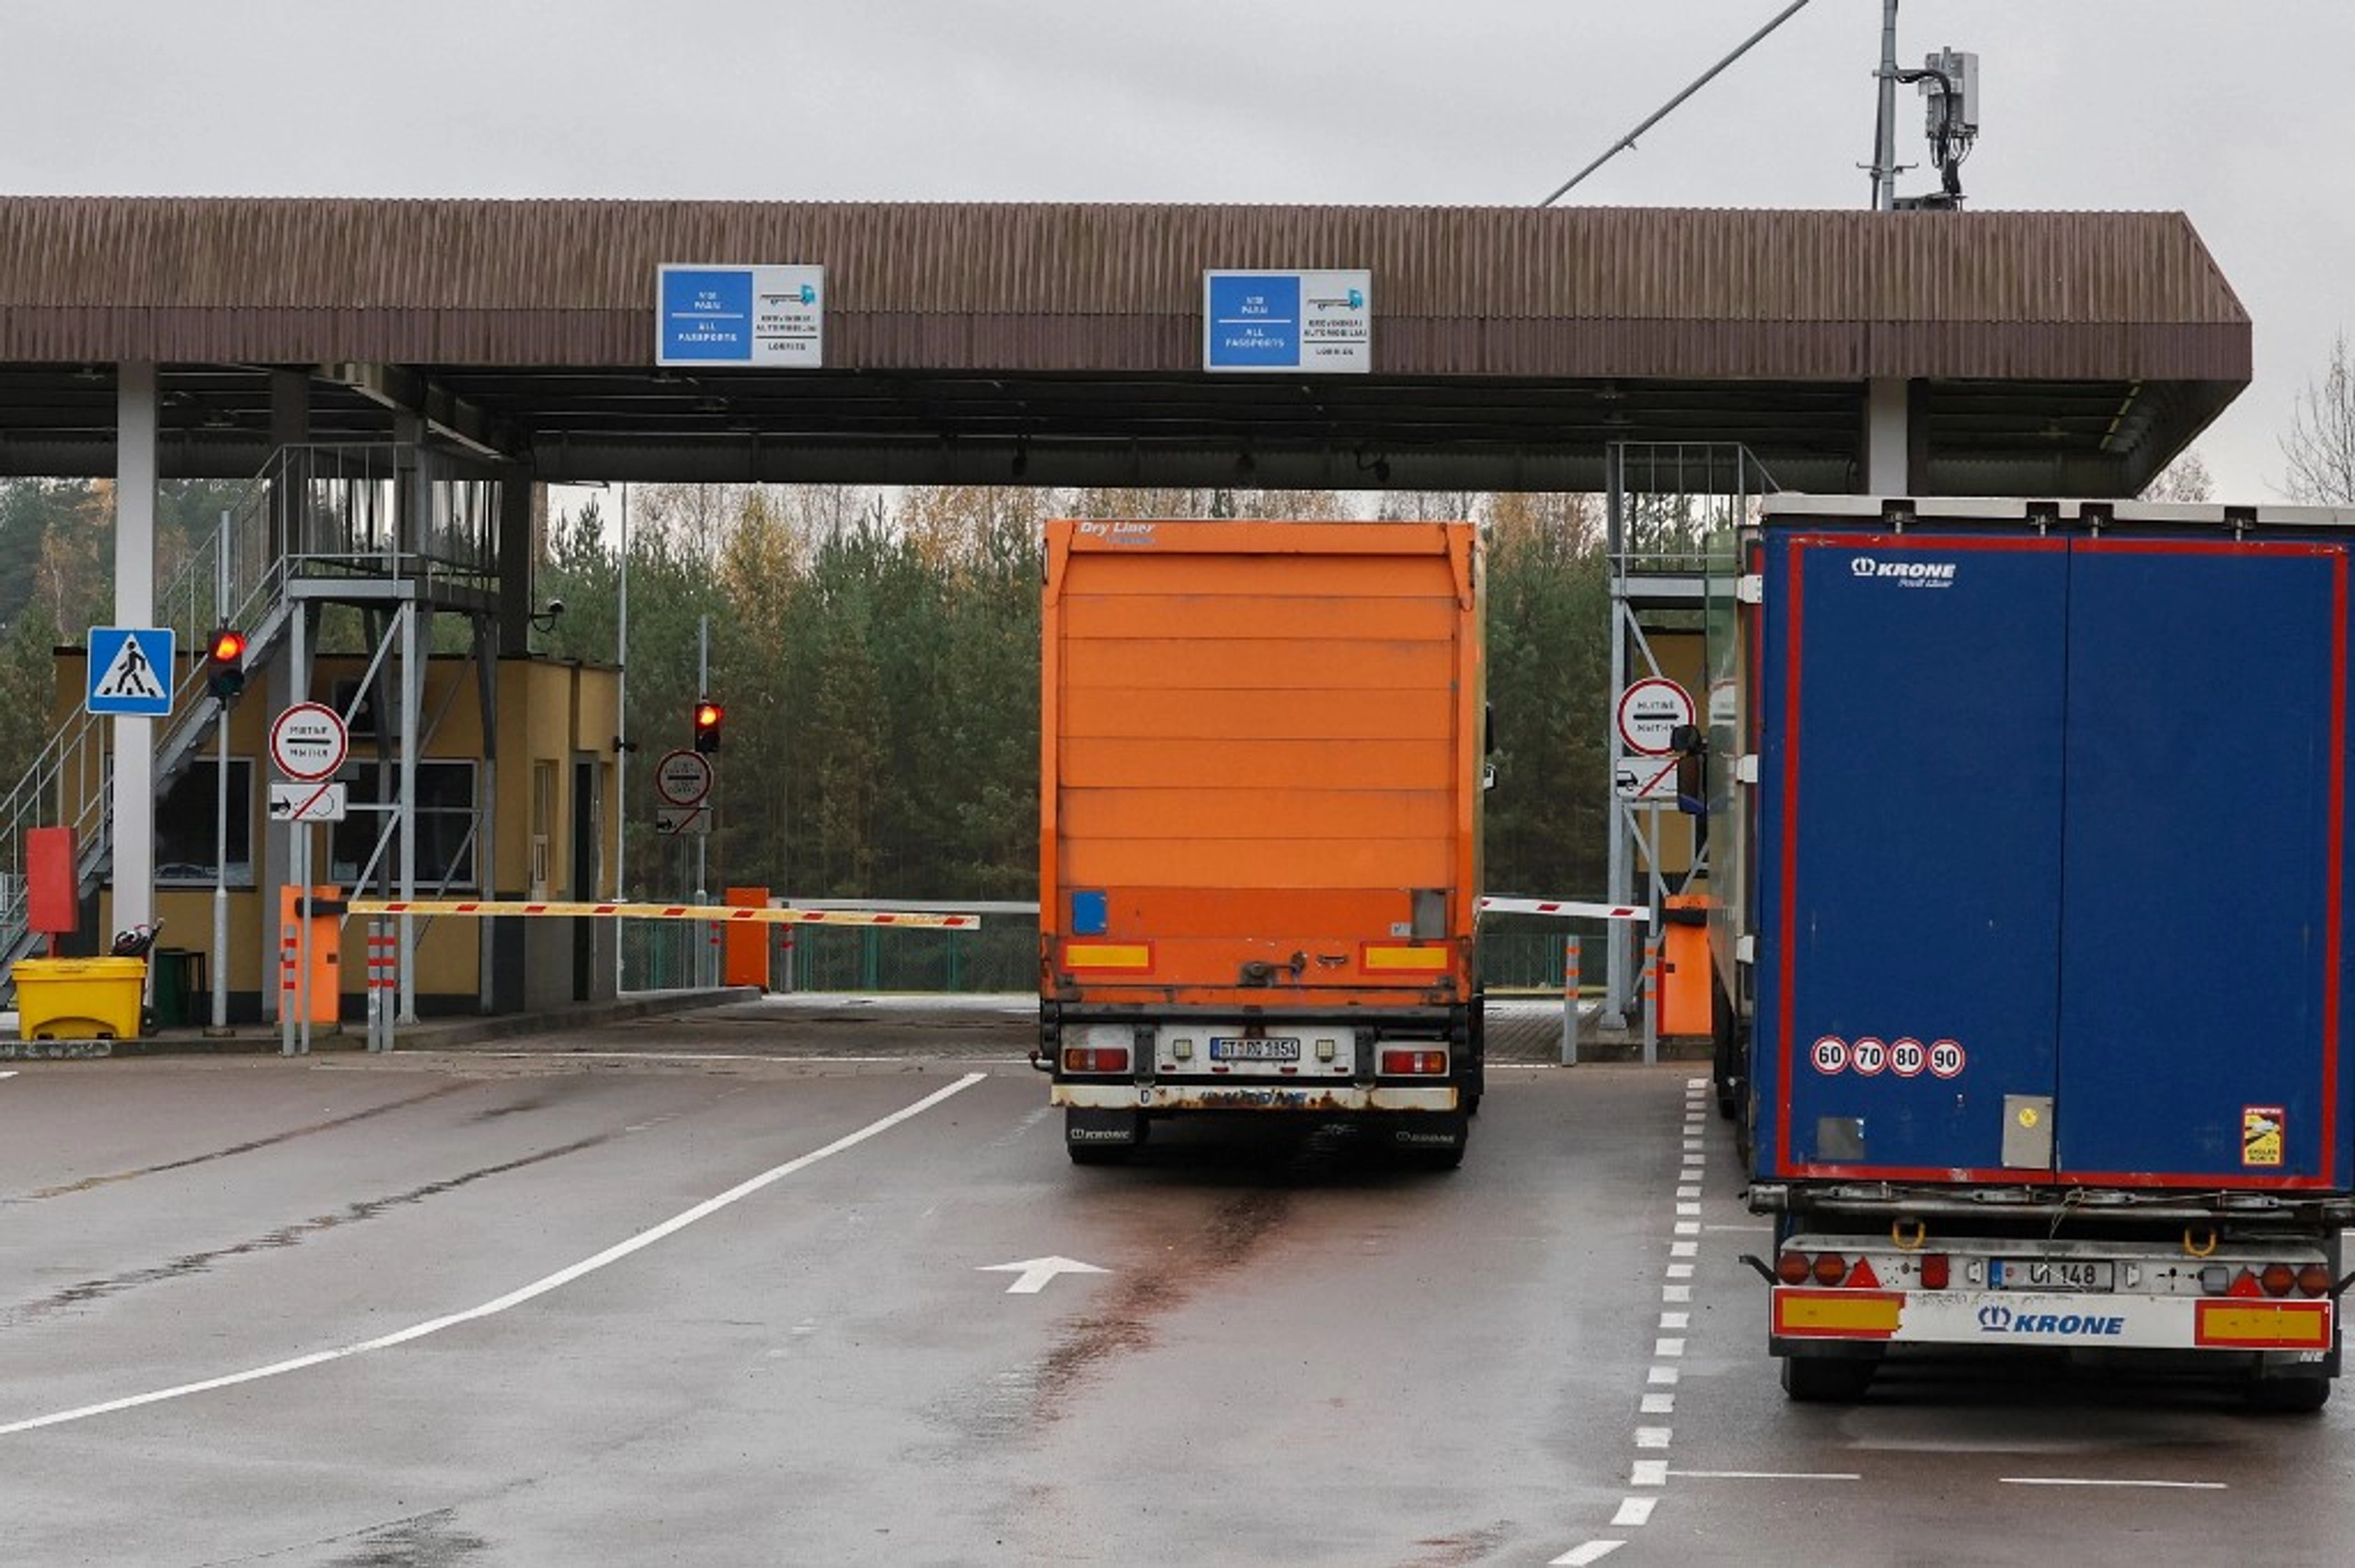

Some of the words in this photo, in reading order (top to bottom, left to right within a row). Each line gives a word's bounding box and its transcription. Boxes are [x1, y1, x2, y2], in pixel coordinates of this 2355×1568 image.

[1080, 521, 1109, 536] Dry
[1113, 521, 1155, 533] Liner
[1877, 563, 1956, 578] KRONE
[1819, 1046, 1841, 1063] 60
[1858, 1048, 1881, 1065] 70
[1897, 1048, 1919, 1066] 80
[1934, 1050, 1957, 1068] 90
[2062, 1265, 2097, 1285] 148
[2013, 1315, 2126, 1334] KRONE
